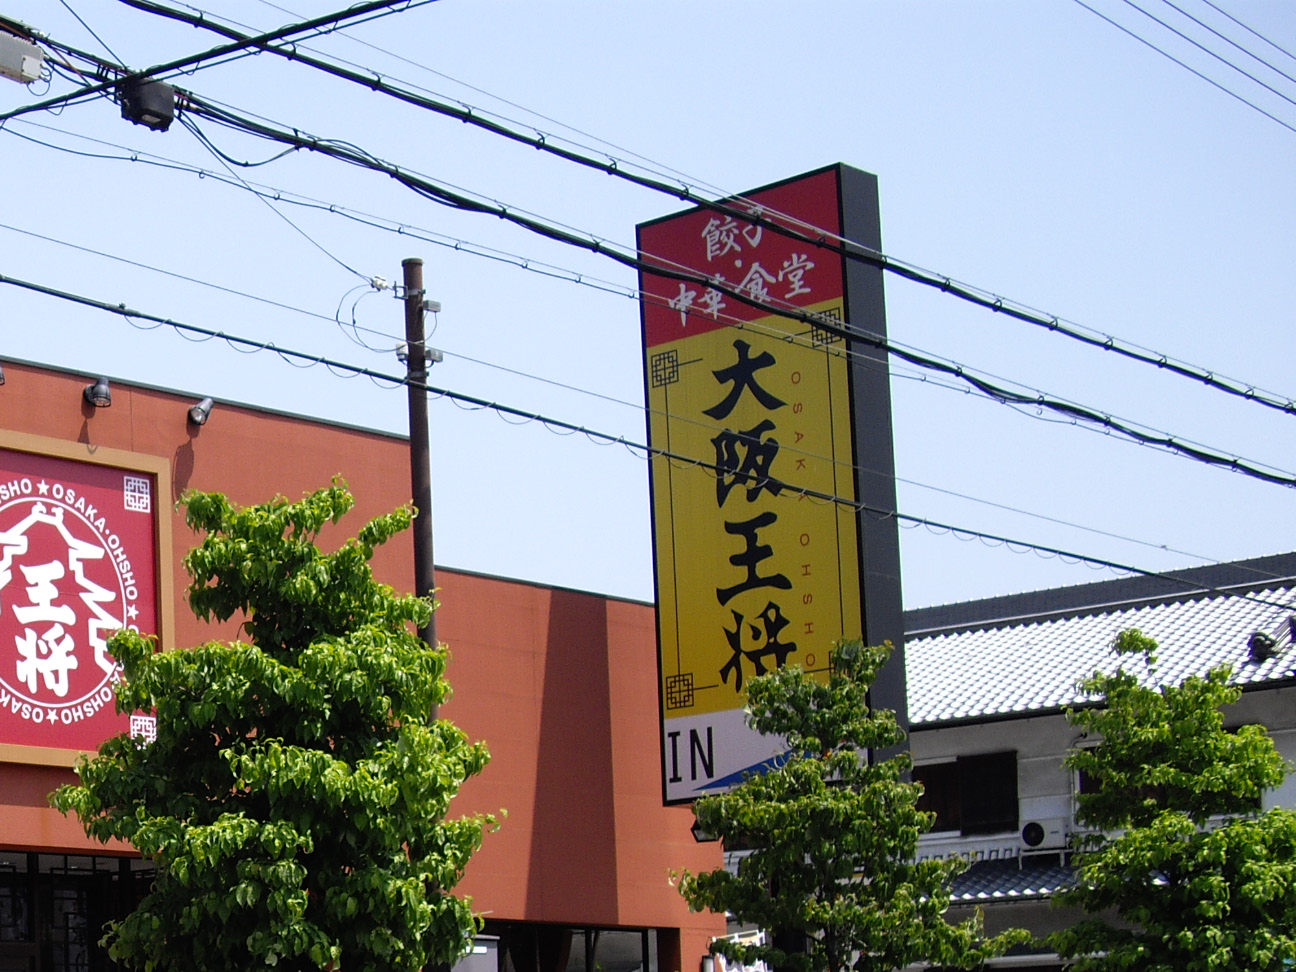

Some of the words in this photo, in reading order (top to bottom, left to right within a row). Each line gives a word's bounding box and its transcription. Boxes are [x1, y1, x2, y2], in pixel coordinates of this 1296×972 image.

[790, 371, 810, 502] OSAKA
[701, 339, 797, 694] 大阪王将
[799, 532, 816, 667] OHSHO
[667, 726, 715, 783] IN
